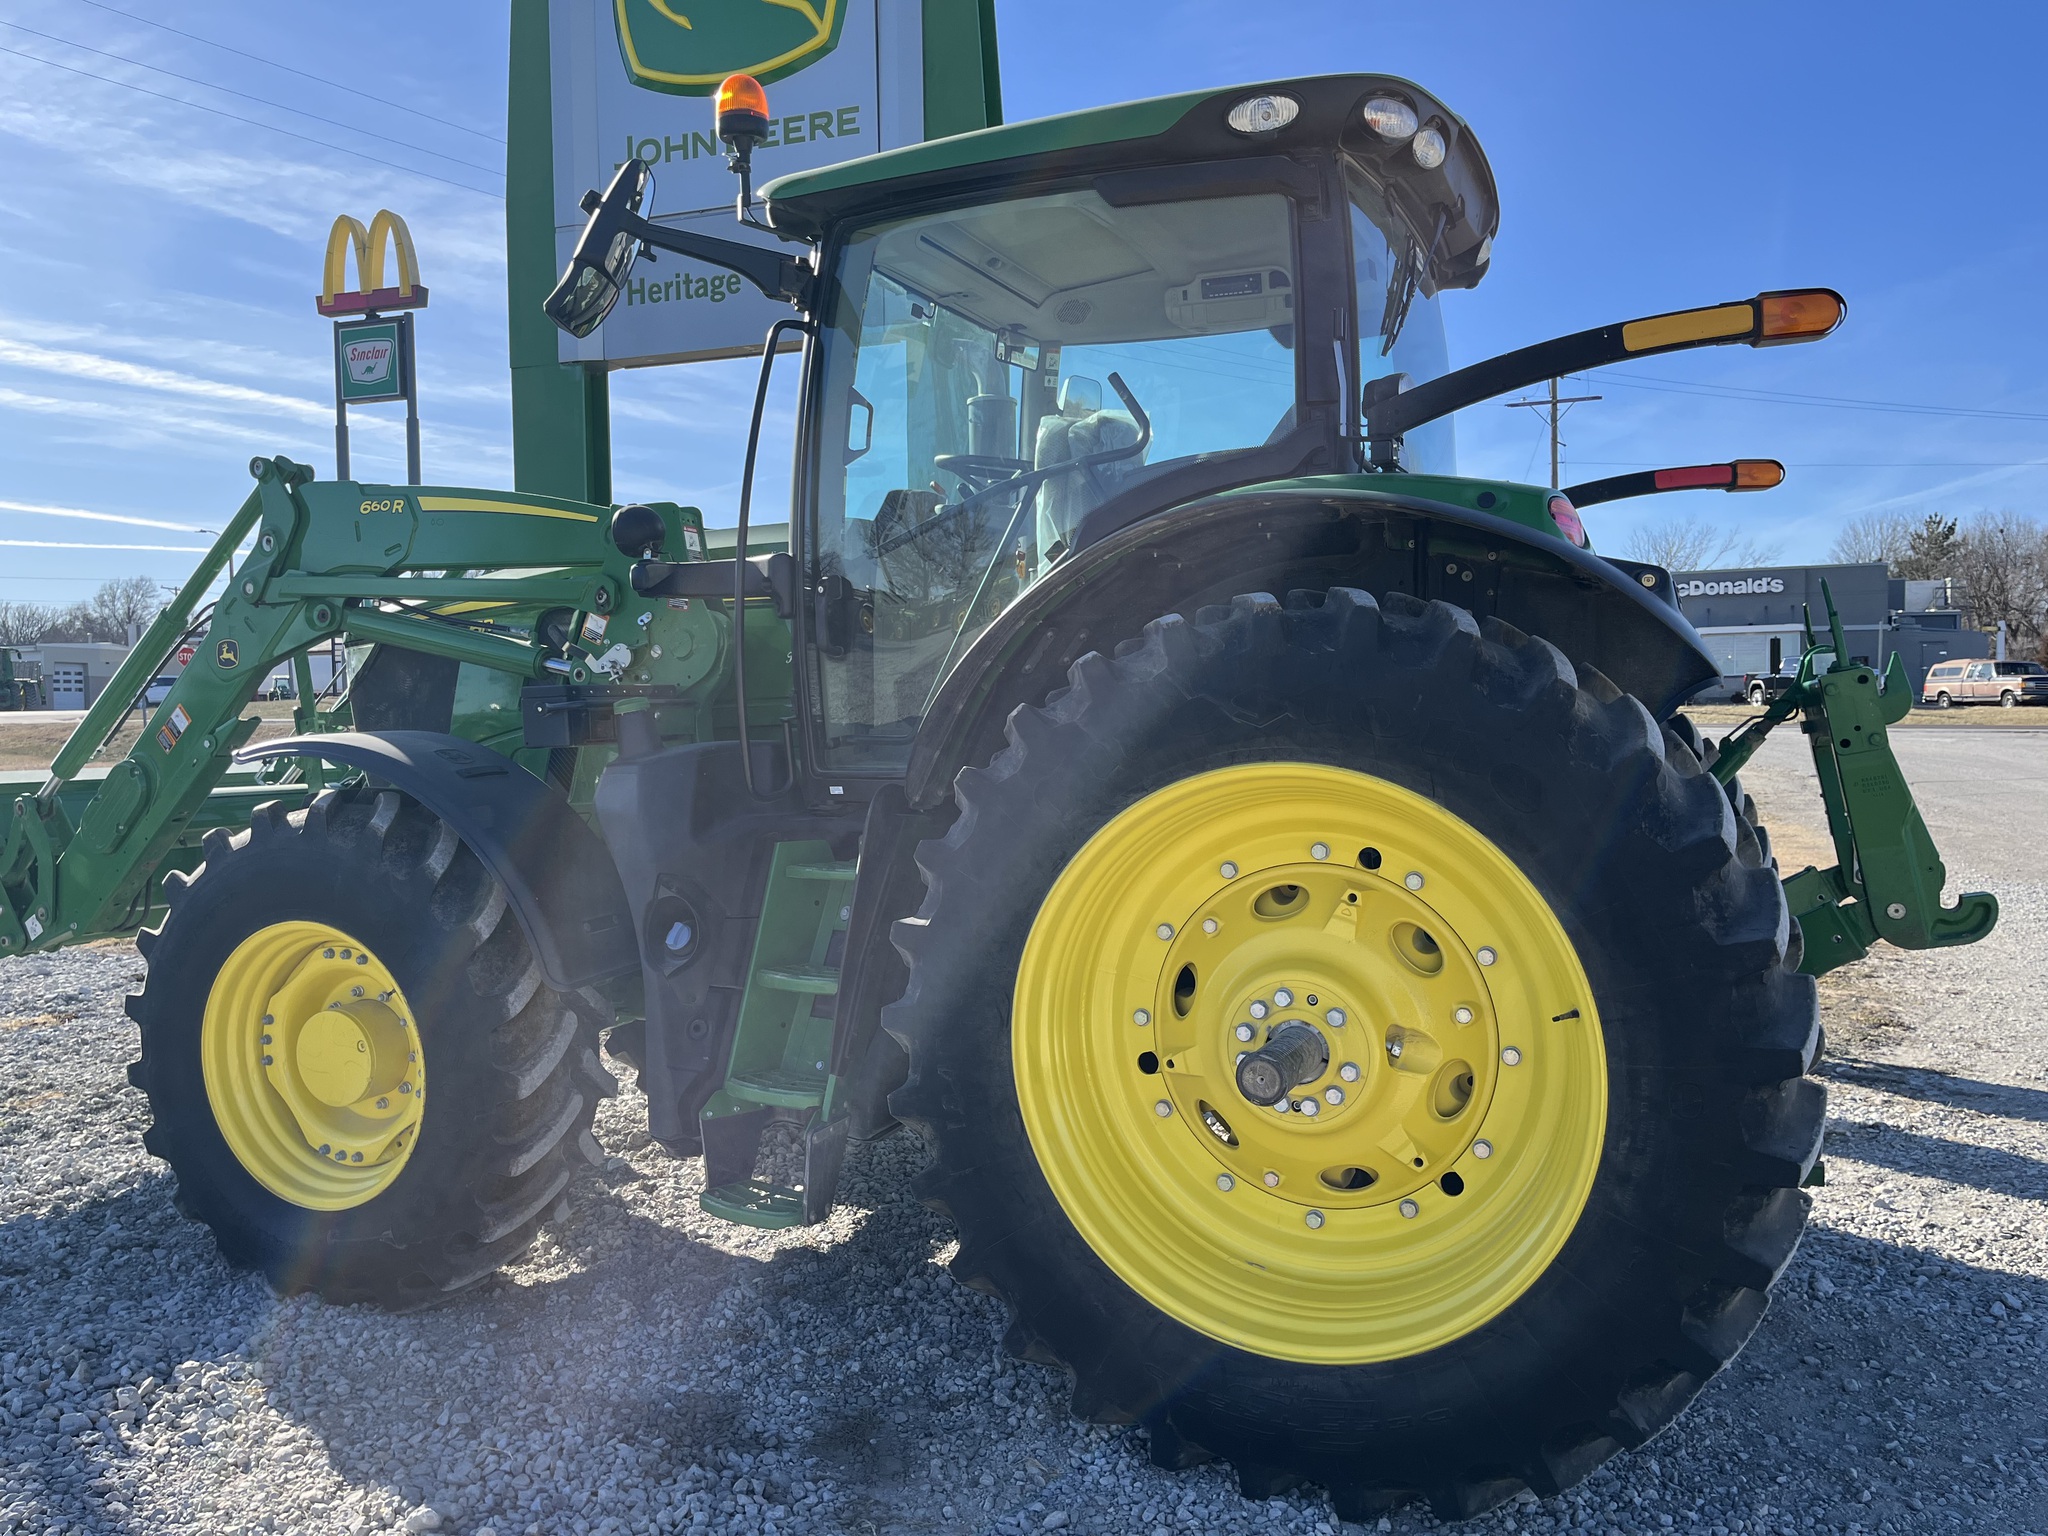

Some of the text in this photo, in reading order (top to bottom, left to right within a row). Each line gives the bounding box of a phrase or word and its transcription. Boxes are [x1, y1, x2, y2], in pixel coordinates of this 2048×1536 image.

[614, 105, 860, 170] JOHN EERE
[627, 272, 742, 306] Heritage
[350, 346, 389, 362] Sinclair
[1676, 577, 1785, 597] cDonald's
[179, 652, 194, 661] STO
